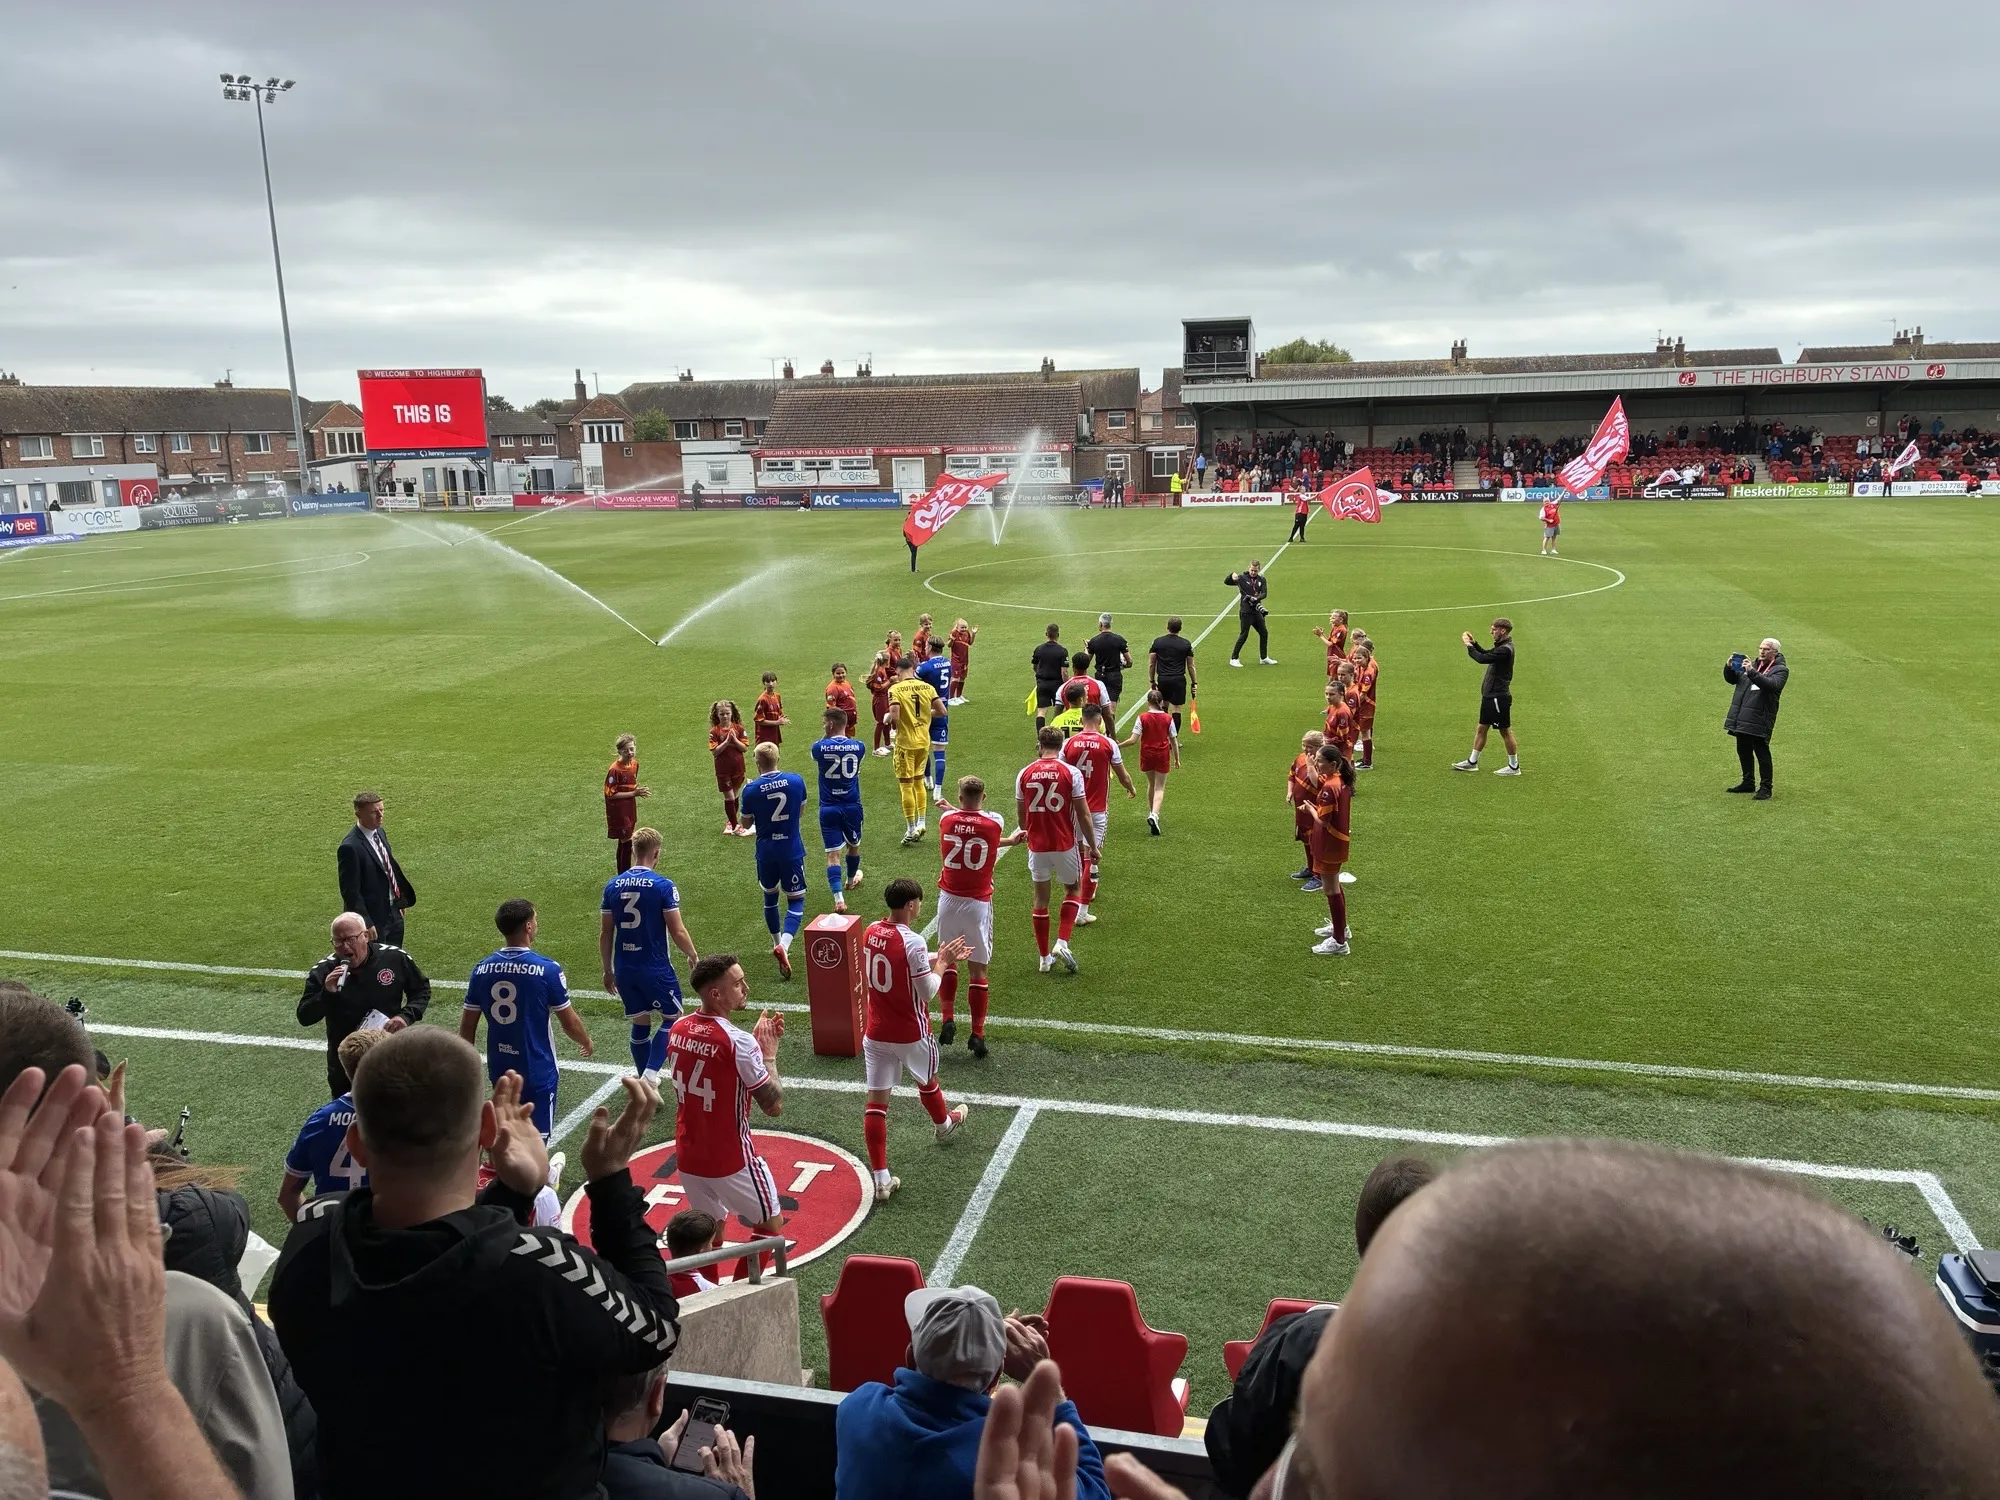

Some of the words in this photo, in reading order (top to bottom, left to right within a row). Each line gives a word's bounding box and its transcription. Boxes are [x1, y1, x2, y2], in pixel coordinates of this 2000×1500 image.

[1712, 371, 1746, 385] THE
[1752, 368, 1844, 384] HIGHBURY
[1850, 366, 1910, 380] STAND
[392, 404, 431, 424] THIS
[434, 404, 452, 423] IS
[1422, 492, 1459, 500] MEATS
[1734, 485, 1818, 496] HeskethPress
[745, 496, 780, 506] Coastal
[814, 495, 840, 506] AGC
[162, 504, 198, 518] SQUIRES
[17, 521, 36, 531] bet
[940, 669, 950, 690] 5
[911, 694, 920, 718] 1
[1074, 741, 1100, 750] BOLTON
[824, 754, 858, 779] 20
[1076, 750, 1094, 778] 4
[760, 779, 789, 792] SENIOR
[1032, 772, 1060, 780] ROONEY
[1026, 782, 1065, 812] 26
[767, 792, 790, 822] 2
[954, 824, 977, 835] NEAL
[944, 834, 989, 871] 20
[615, 878, 654, 888] SPARKES
[620, 892, 642, 929] 3
[868, 934, 886, 950] HELM
[476, 962, 544, 976] HUTCHINSON
[863, 946, 892, 993] 10
[490, 980, 517, 1025] 8
[669, 1033, 718, 1058] MULLARKEY
[670, 1052, 716, 1112] 44
[329, 1137, 367, 1190] 4
